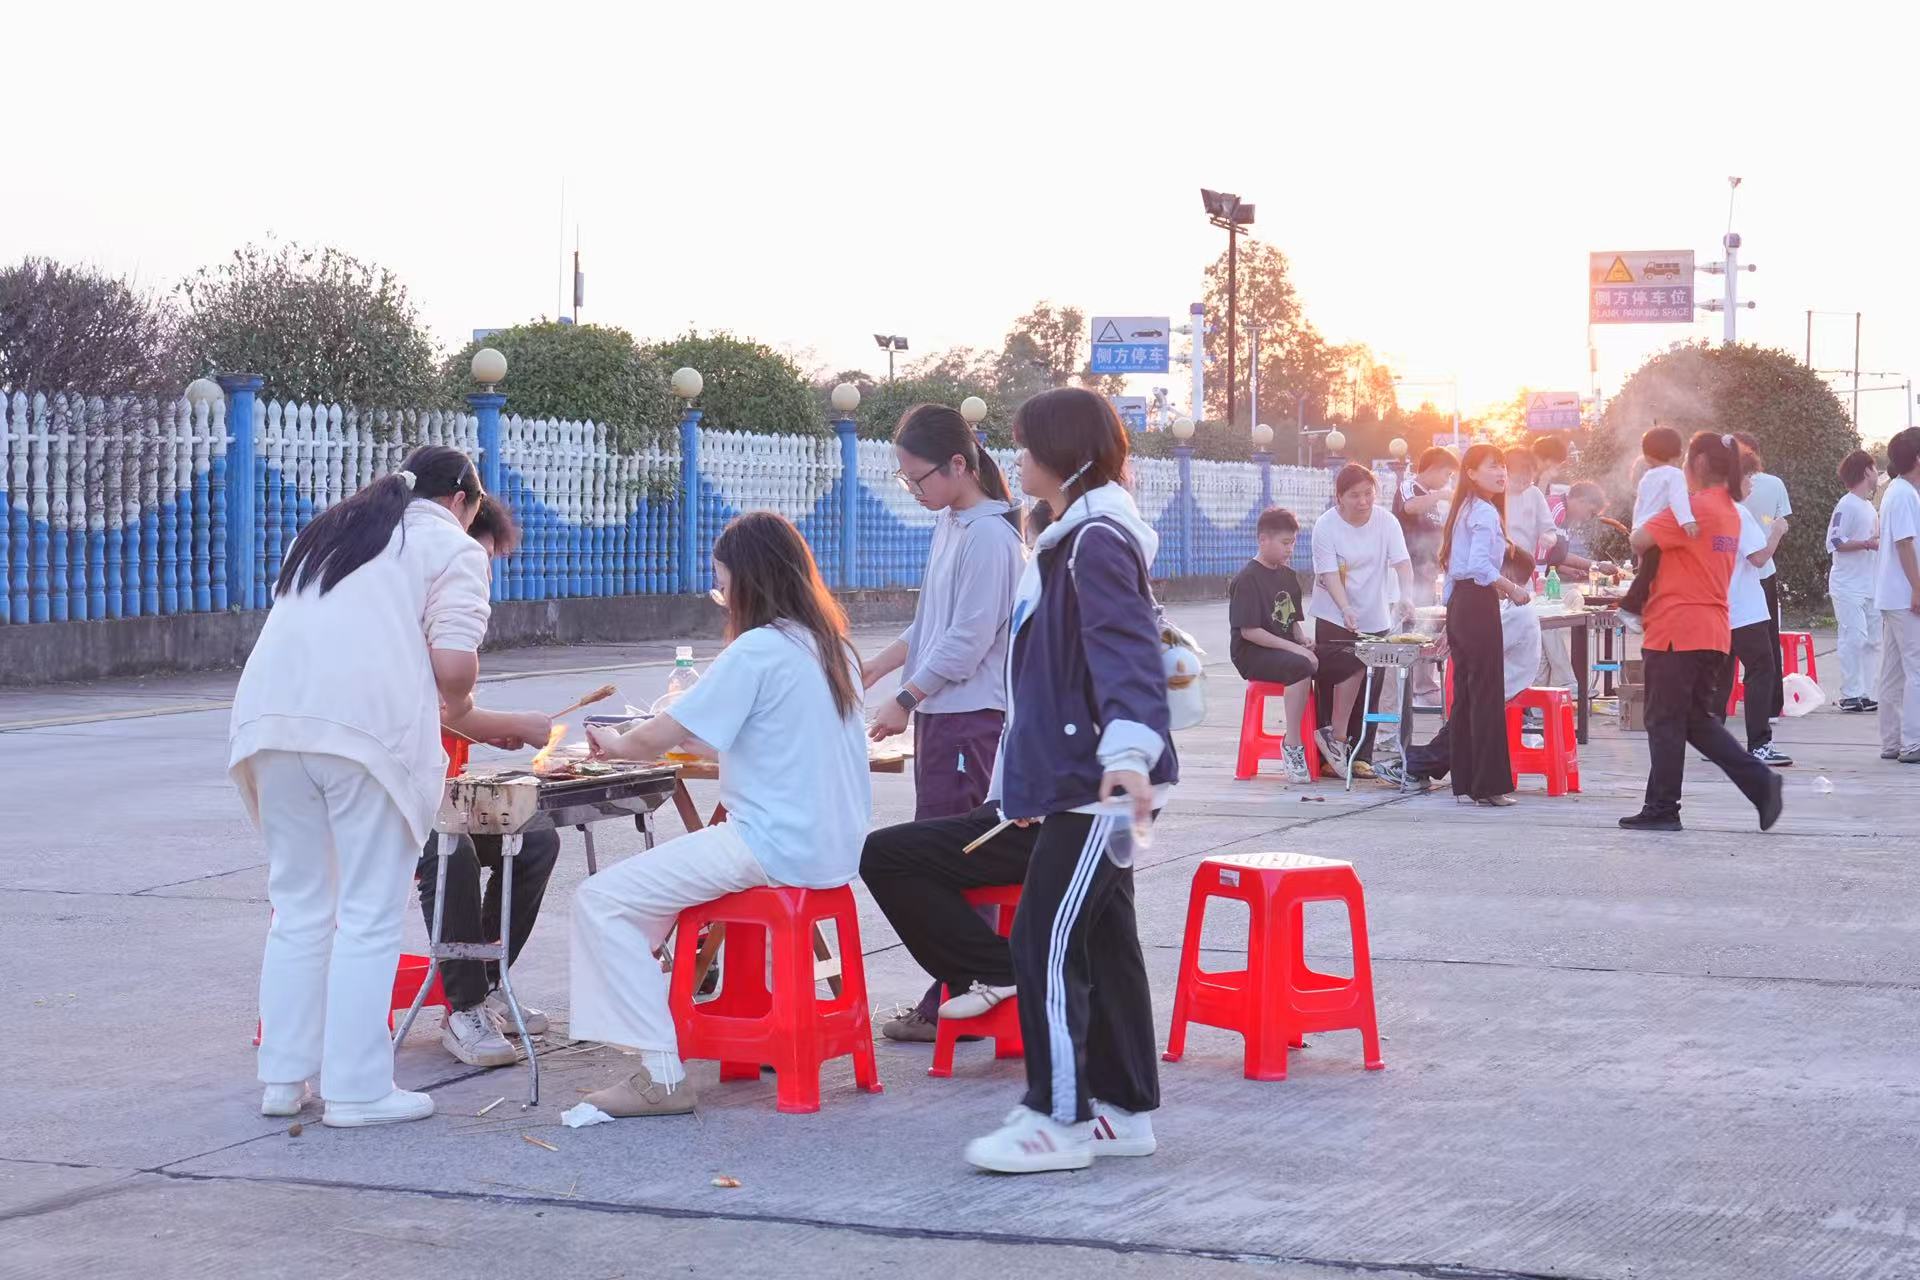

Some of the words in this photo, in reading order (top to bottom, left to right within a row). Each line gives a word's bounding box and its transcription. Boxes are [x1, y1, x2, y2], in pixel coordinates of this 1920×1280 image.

[1595, 289, 1687, 306] 侧方停车位
[1662, 307, 1689, 316] SPACE
[1096, 347, 1165, 364] 侧方停车
